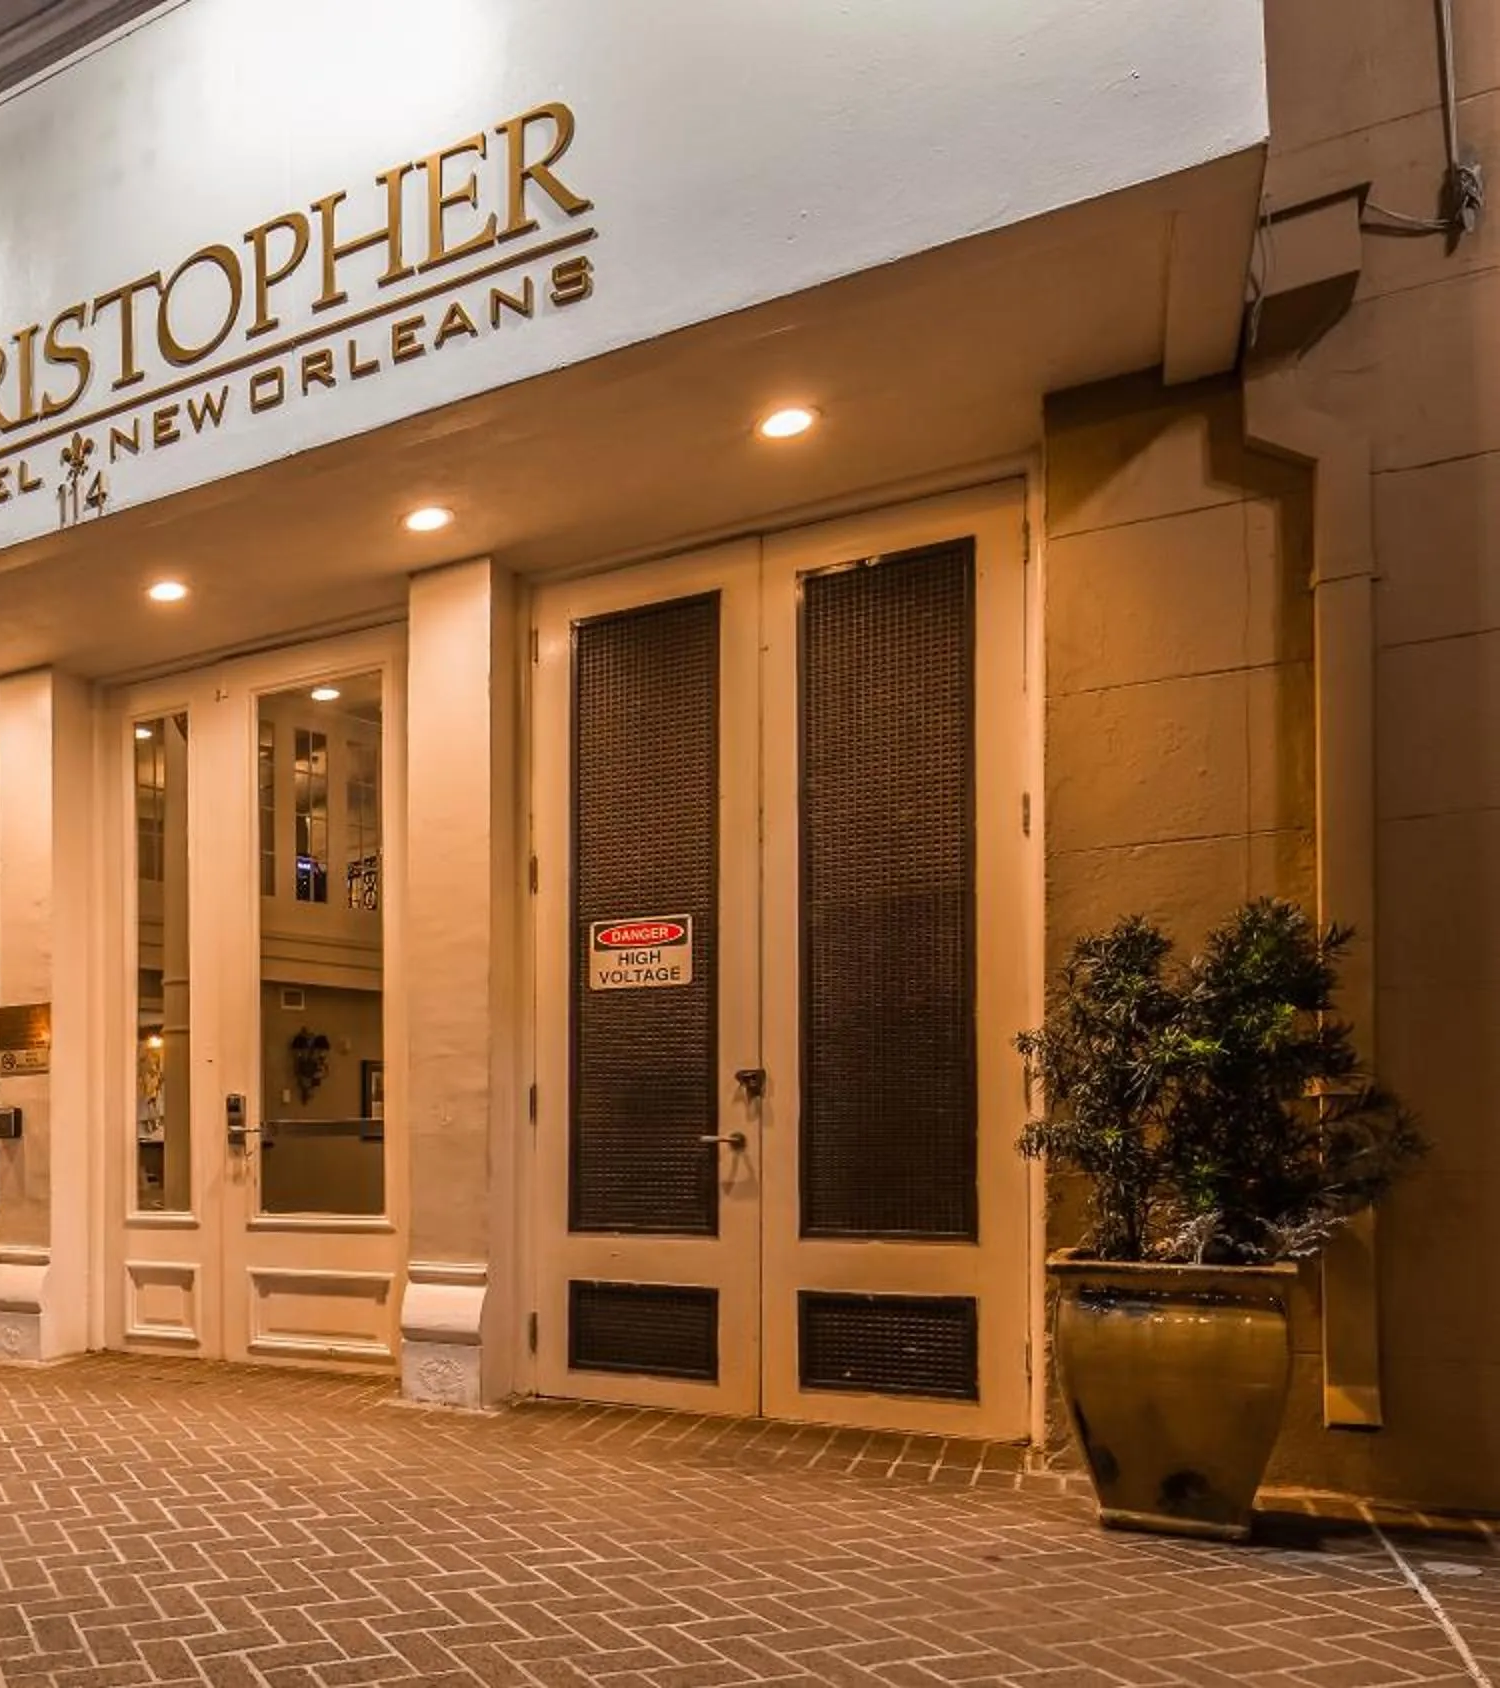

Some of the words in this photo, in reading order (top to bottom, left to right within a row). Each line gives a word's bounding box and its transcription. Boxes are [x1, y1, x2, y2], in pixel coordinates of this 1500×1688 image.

[108, 384, 229, 464] NEW
[249, 253, 594, 414] ORLEANS
[56, 470, 108, 530] 114
[611, 927, 669, 942] DANGER
[618, 950, 661, 966] HIGH
[599, 966, 681, 984] VOLTAGE
